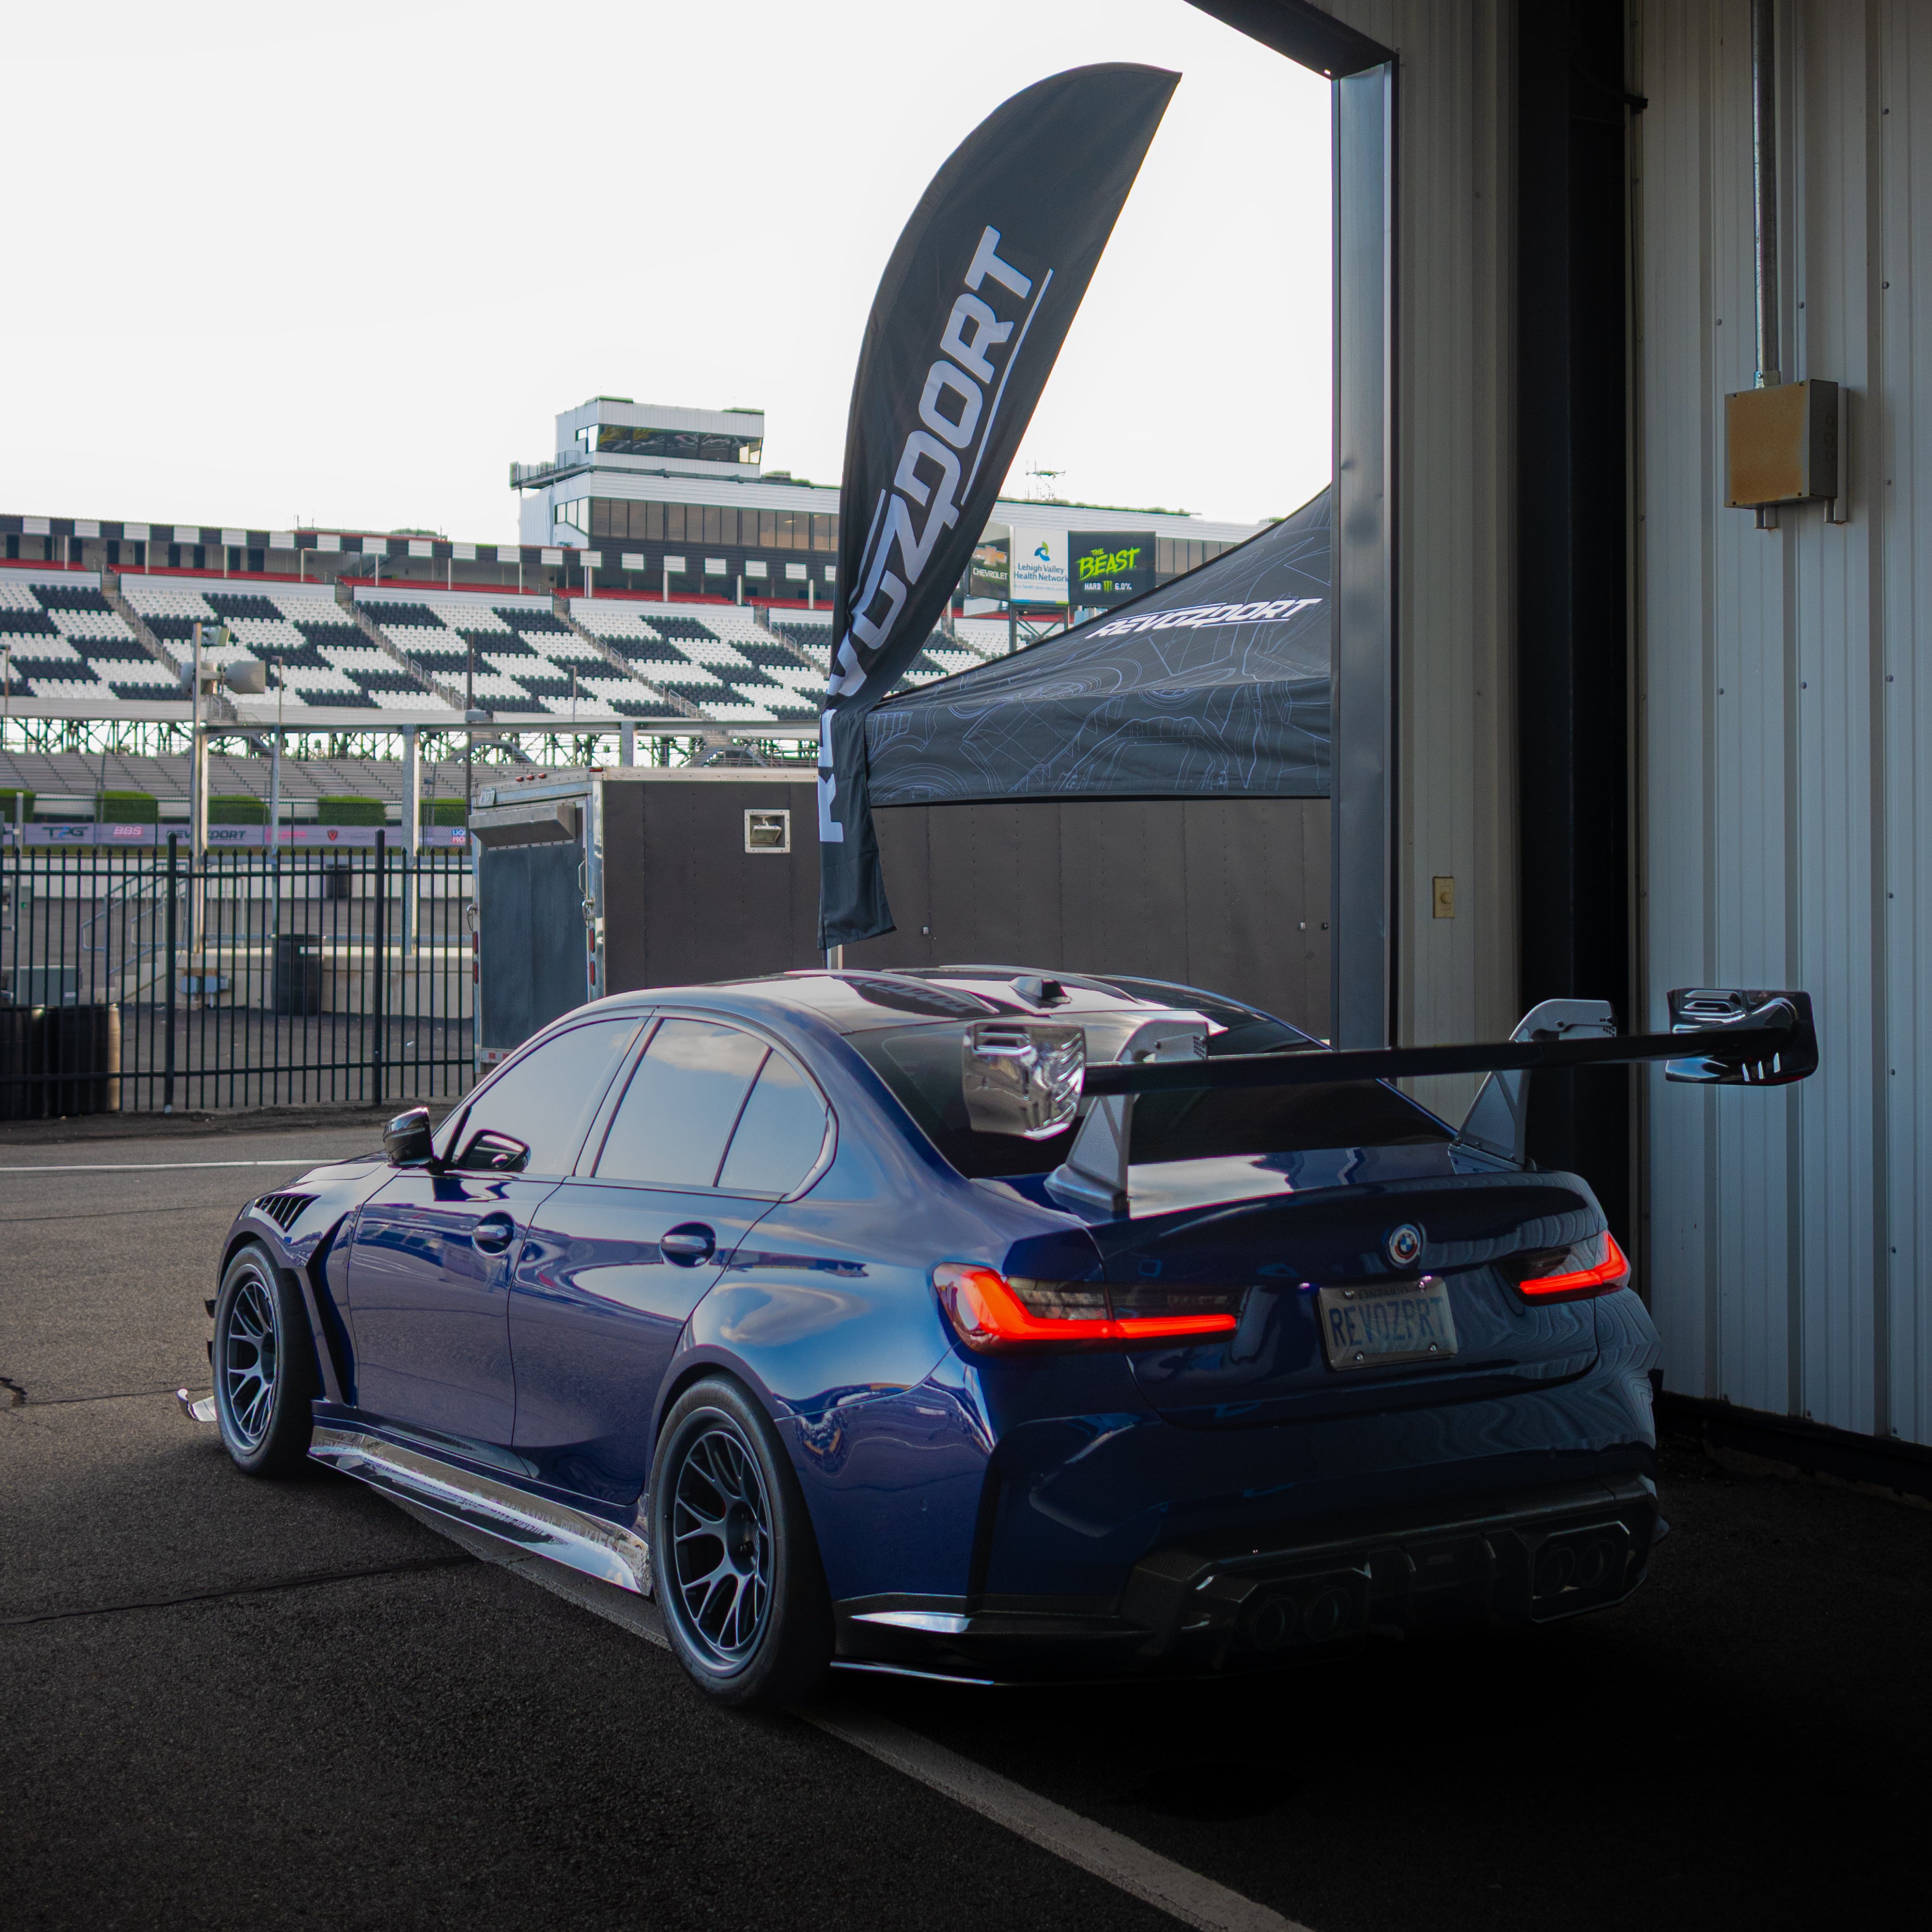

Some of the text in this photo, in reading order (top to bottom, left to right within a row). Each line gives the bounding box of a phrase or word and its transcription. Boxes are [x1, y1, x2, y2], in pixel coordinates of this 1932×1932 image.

[1018, 563, 1064, 575] Lehigh Valley
[1075, 547, 1140, 581] BEAST
[973, 567, 1008, 580] CHEVROLET
[1014, 571, 1069, 582] Health Network
[1085, 598, 1323, 639] REVOZPORT
[113, 826, 143, 836] BBS
[1329, 1297, 1445, 1348] REVOZPRT
